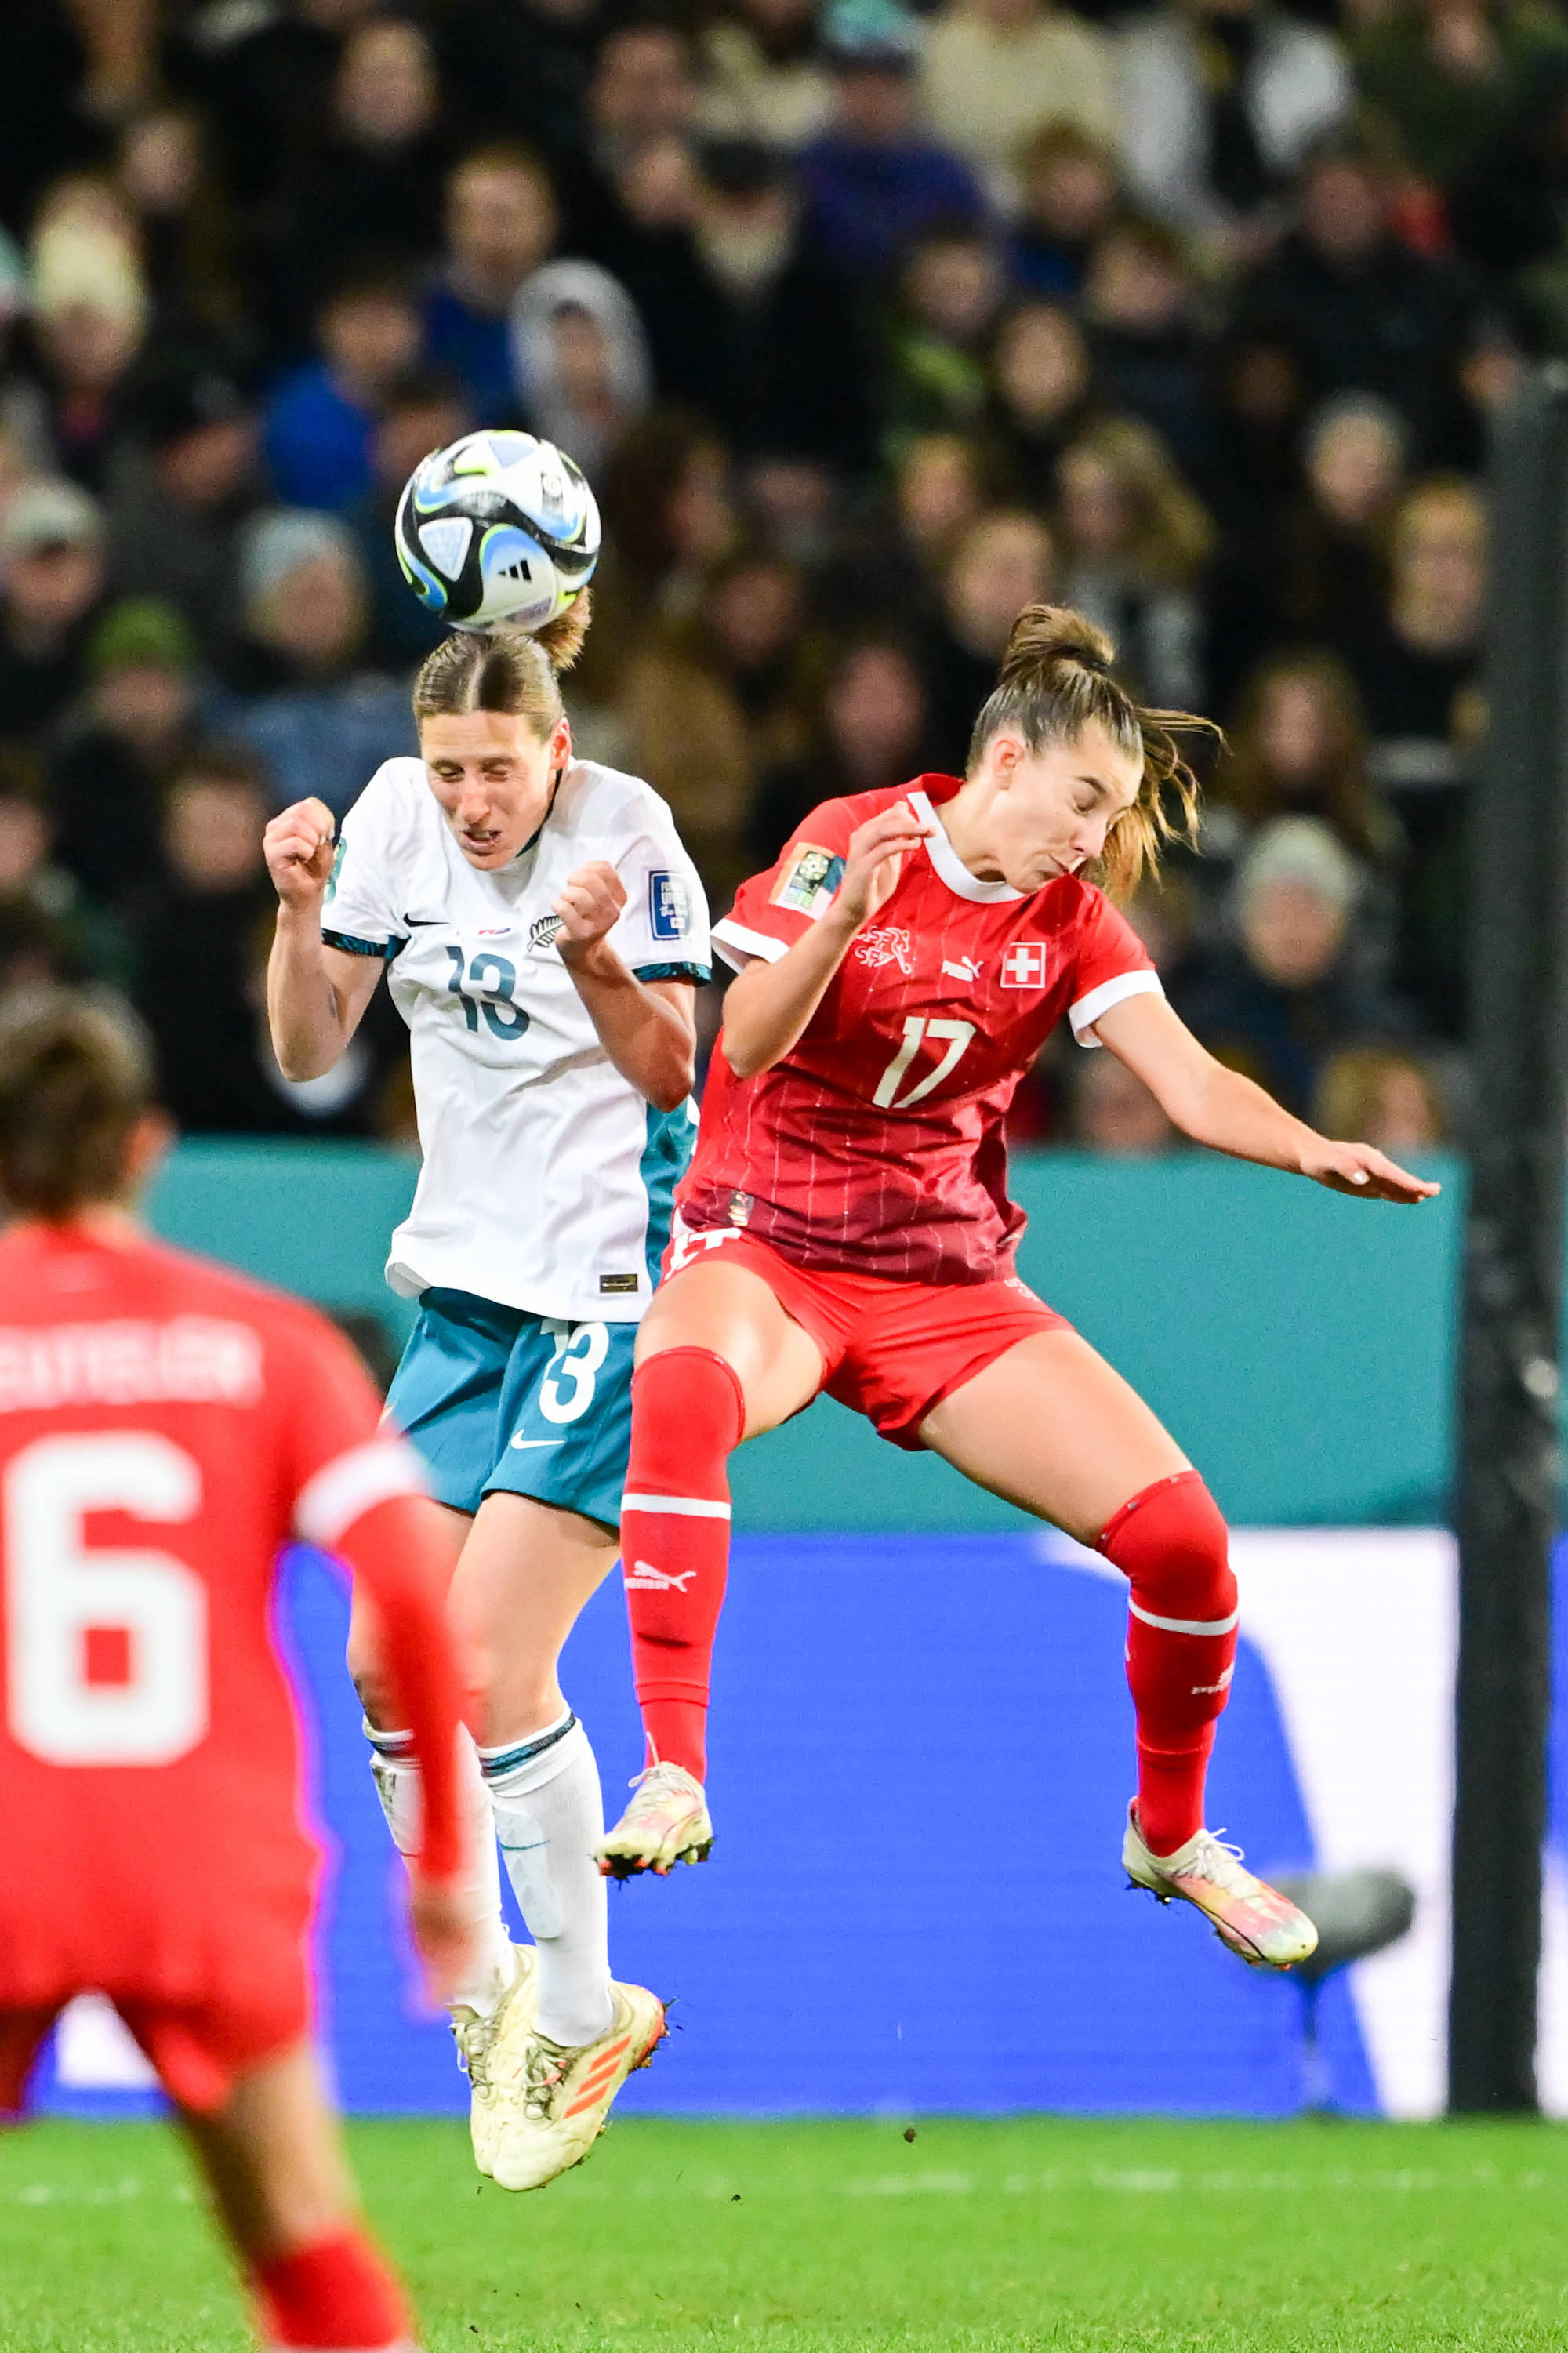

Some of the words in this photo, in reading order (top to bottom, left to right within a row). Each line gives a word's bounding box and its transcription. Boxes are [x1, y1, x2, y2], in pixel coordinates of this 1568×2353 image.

[446, 946, 530, 1041] 13
[872, 1016, 977, 1109] 17
[3, 1429, 211, 1768] 6
